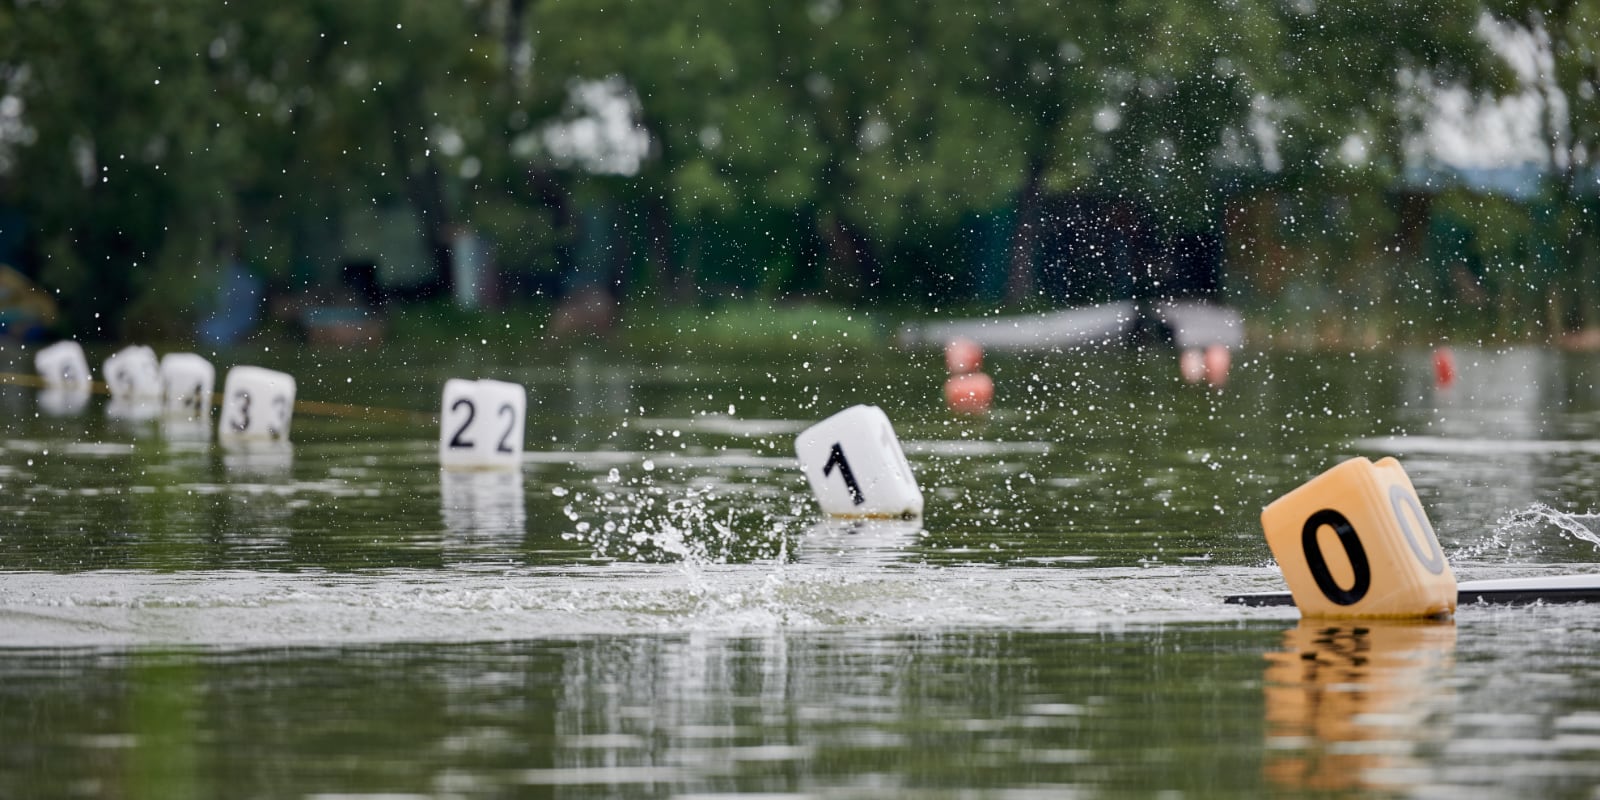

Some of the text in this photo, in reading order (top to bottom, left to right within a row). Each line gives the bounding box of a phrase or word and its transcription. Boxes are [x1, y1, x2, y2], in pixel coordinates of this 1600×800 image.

[184, 381, 202, 415] 4
[230, 389, 252, 432] 3
[449, 398, 476, 449] 2
[496, 404, 516, 453] 2
[822, 441, 865, 506] 1
[1389, 485, 1444, 575] 0
[1302, 508, 1371, 606] 0
